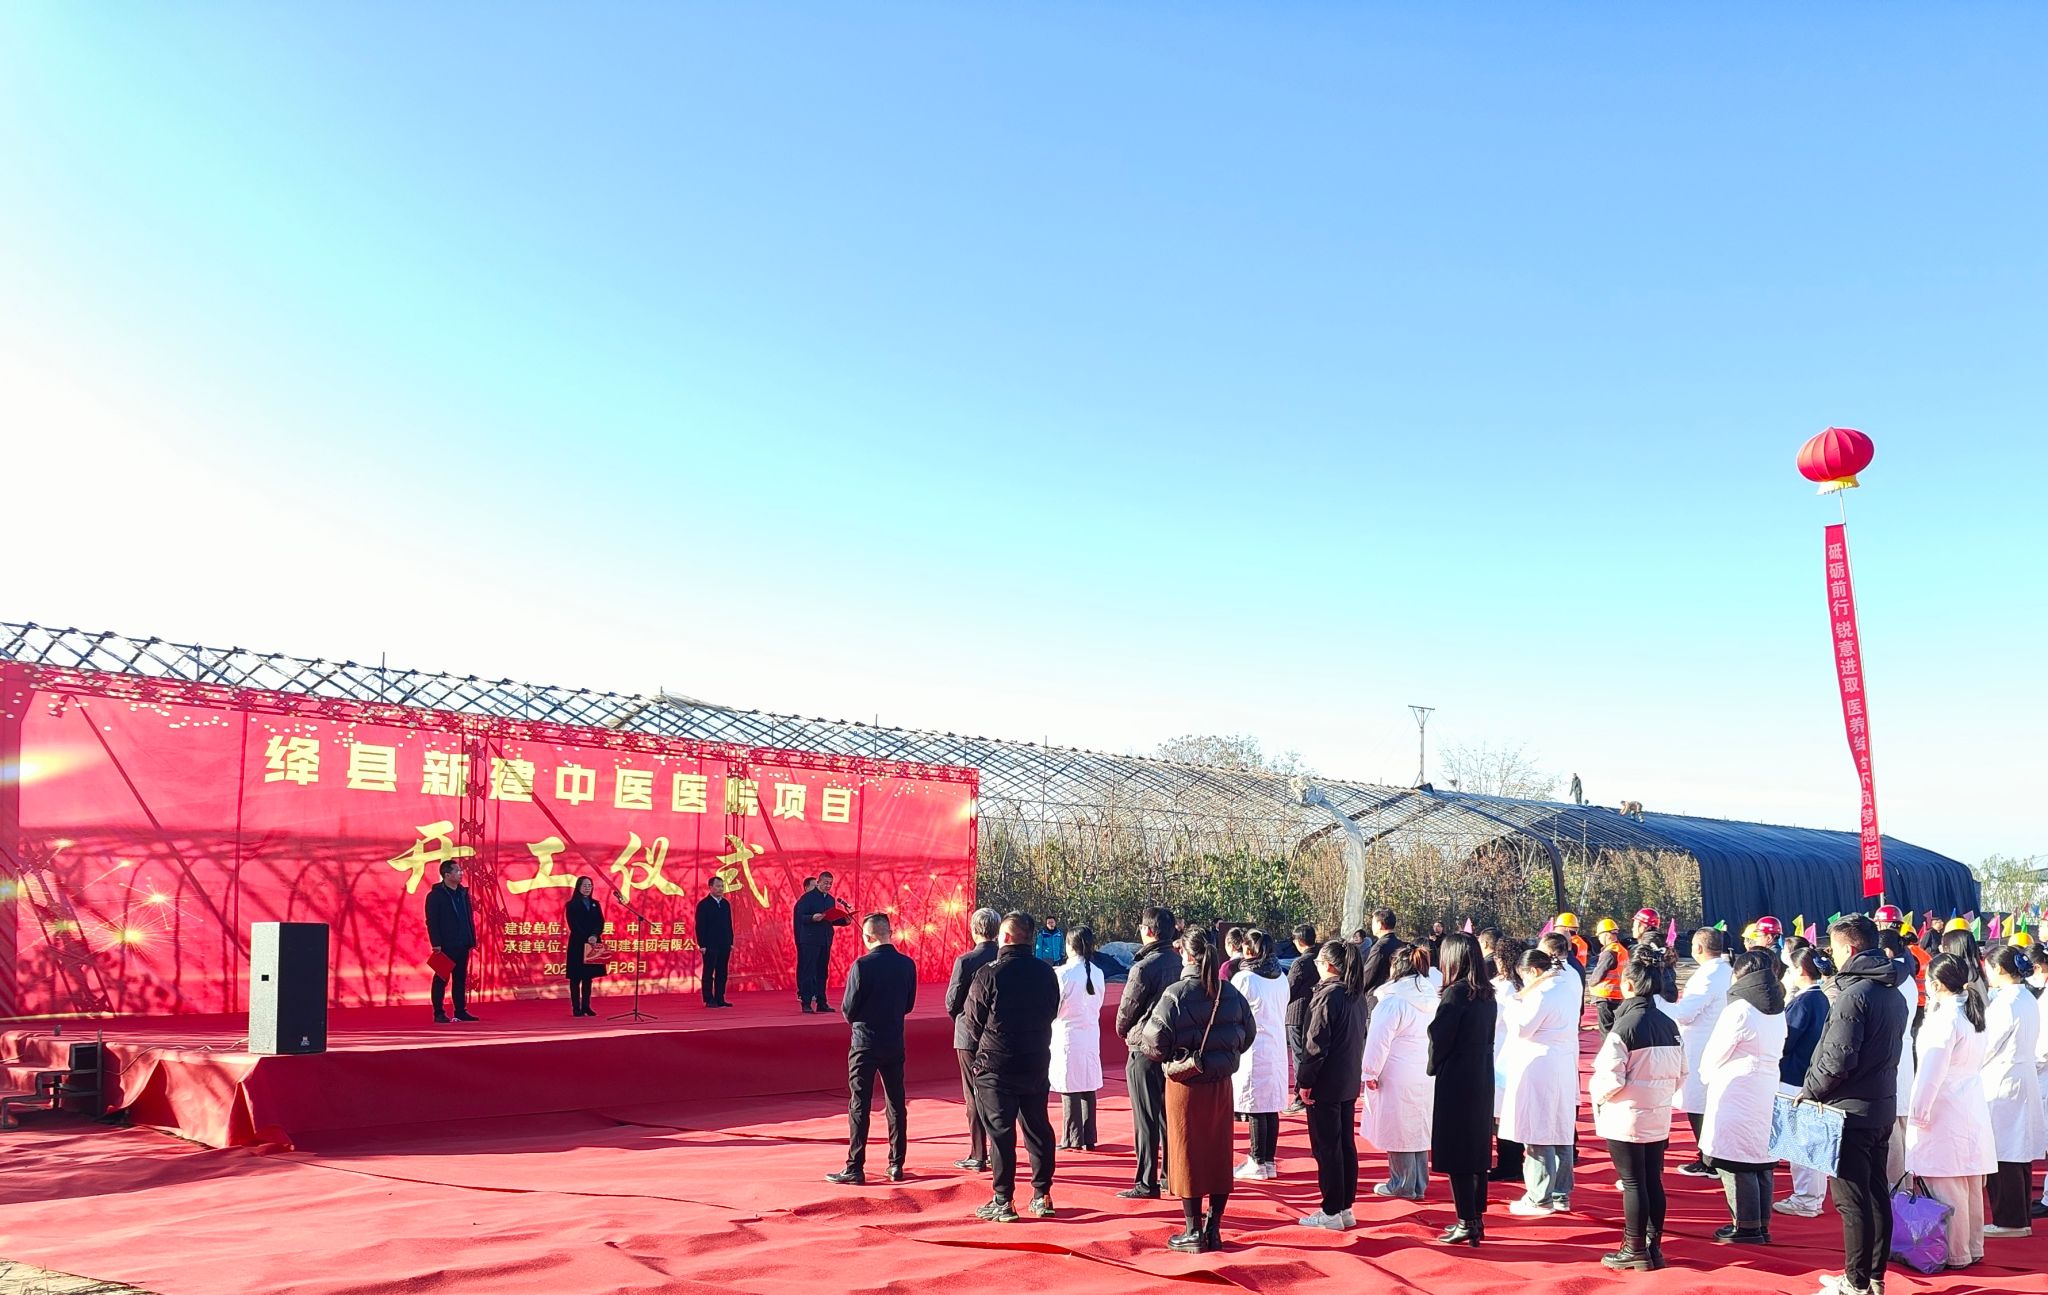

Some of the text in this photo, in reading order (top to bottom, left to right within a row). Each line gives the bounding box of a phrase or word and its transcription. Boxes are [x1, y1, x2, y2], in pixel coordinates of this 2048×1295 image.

[1828, 543, 1849, 616] 砥砺前行
[1835, 622, 1860, 693] 锐意进取
[264, 735, 852, 823] 绛县新建中医医院项目
[387, 820, 770, 909] 开工仪式
